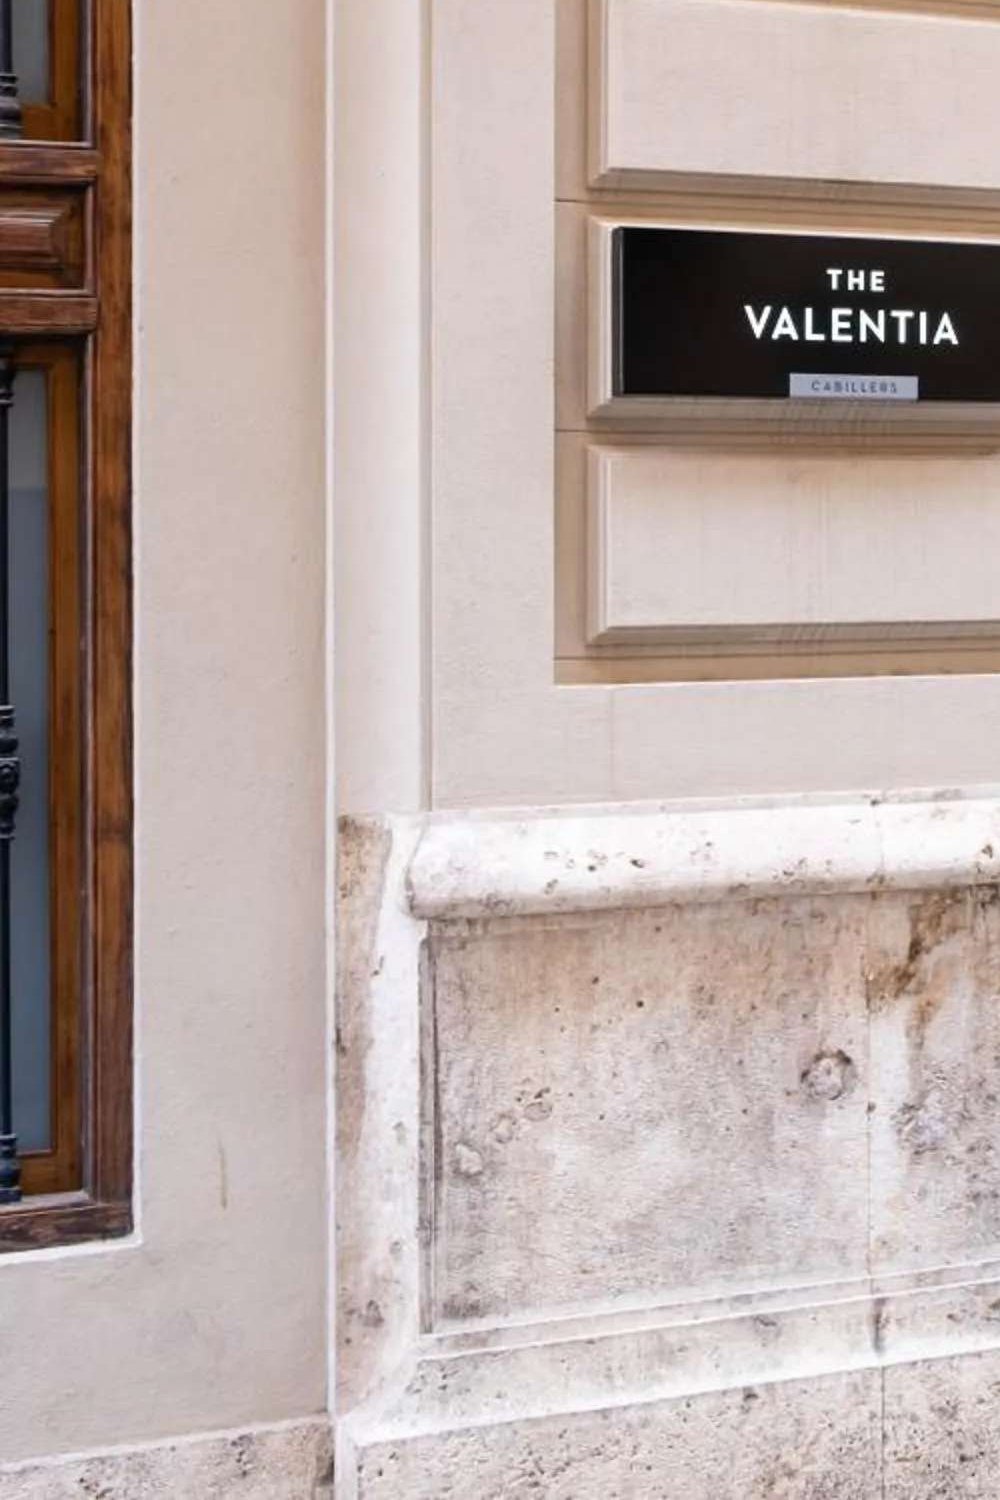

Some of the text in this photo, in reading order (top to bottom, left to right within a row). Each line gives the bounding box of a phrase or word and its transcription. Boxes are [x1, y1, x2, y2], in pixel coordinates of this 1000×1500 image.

[826, 268, 886, 293] THE
[744, 304, 960, 346] VALENTIA
[811, 379, 898, 395] CABILLERS
